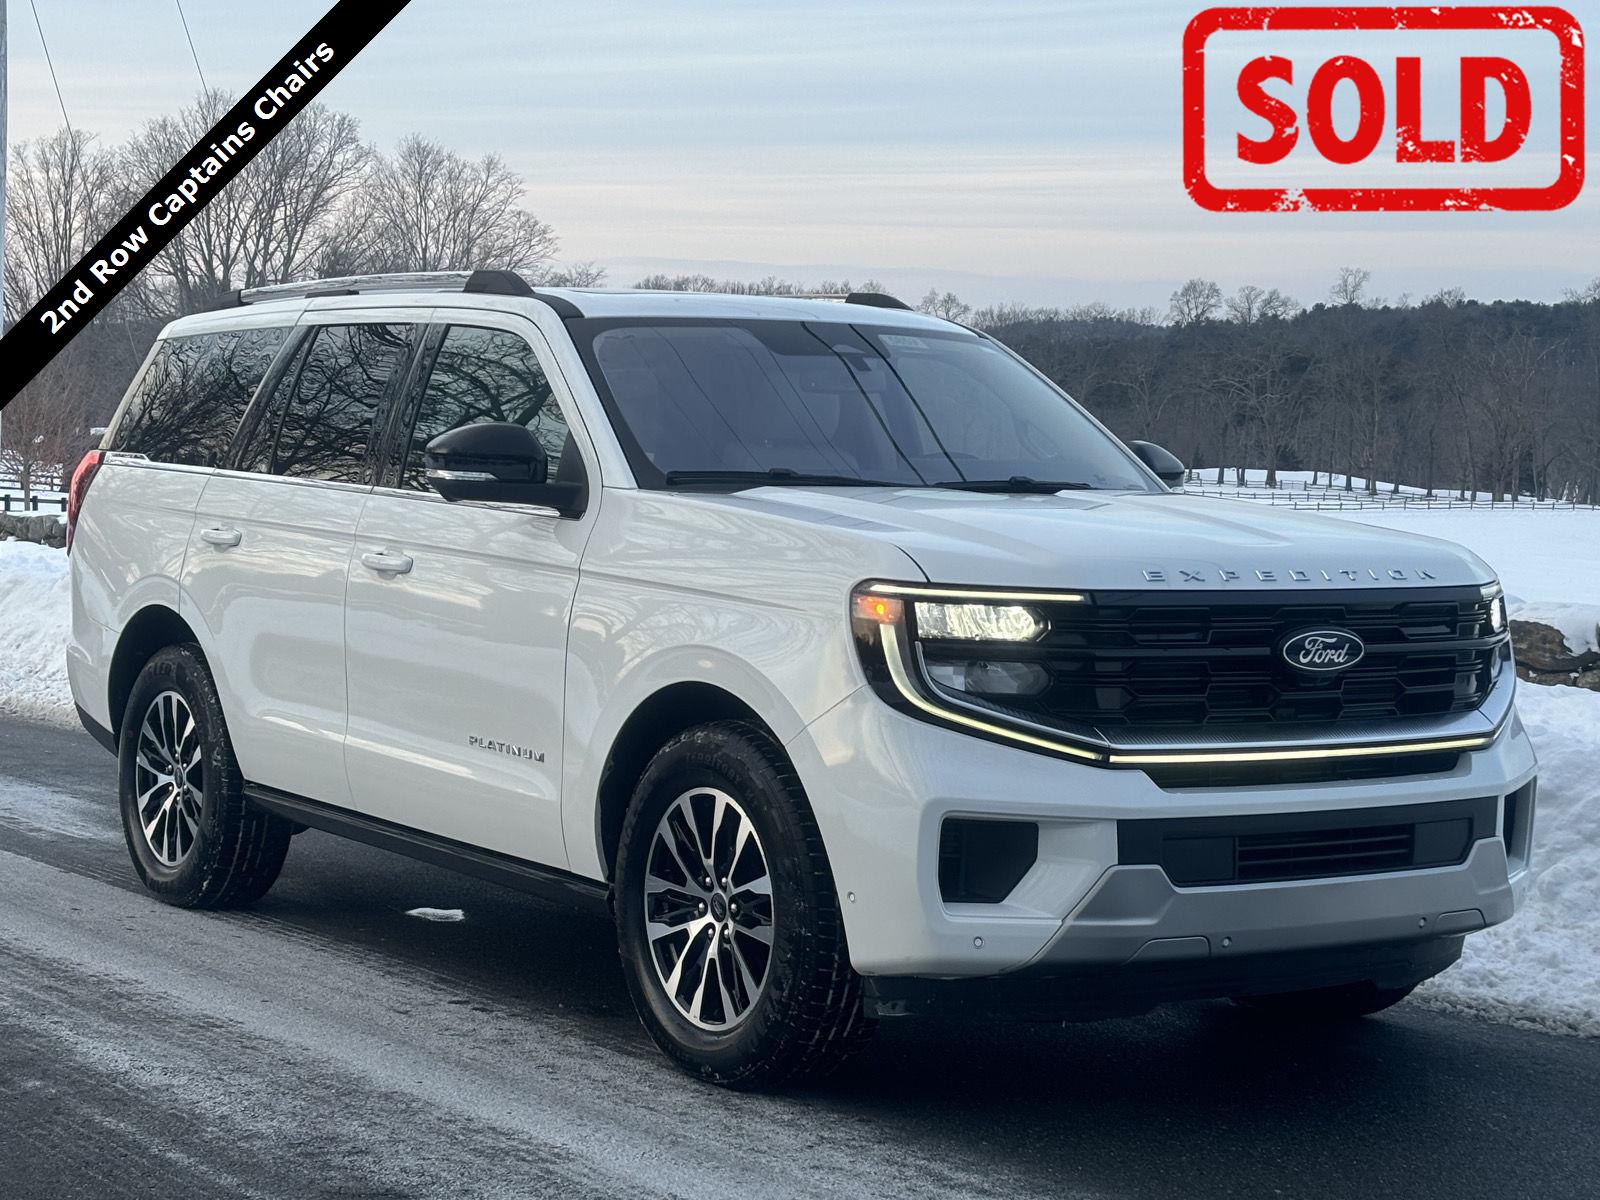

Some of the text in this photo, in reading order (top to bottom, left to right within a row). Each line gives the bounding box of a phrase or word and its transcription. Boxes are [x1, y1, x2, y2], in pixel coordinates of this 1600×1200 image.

[1142, 568, 1437, 583] EXPEDITION
[1299, 637, 1350, 664] Ford
[468, 735, 545, 763] PLATINUM
